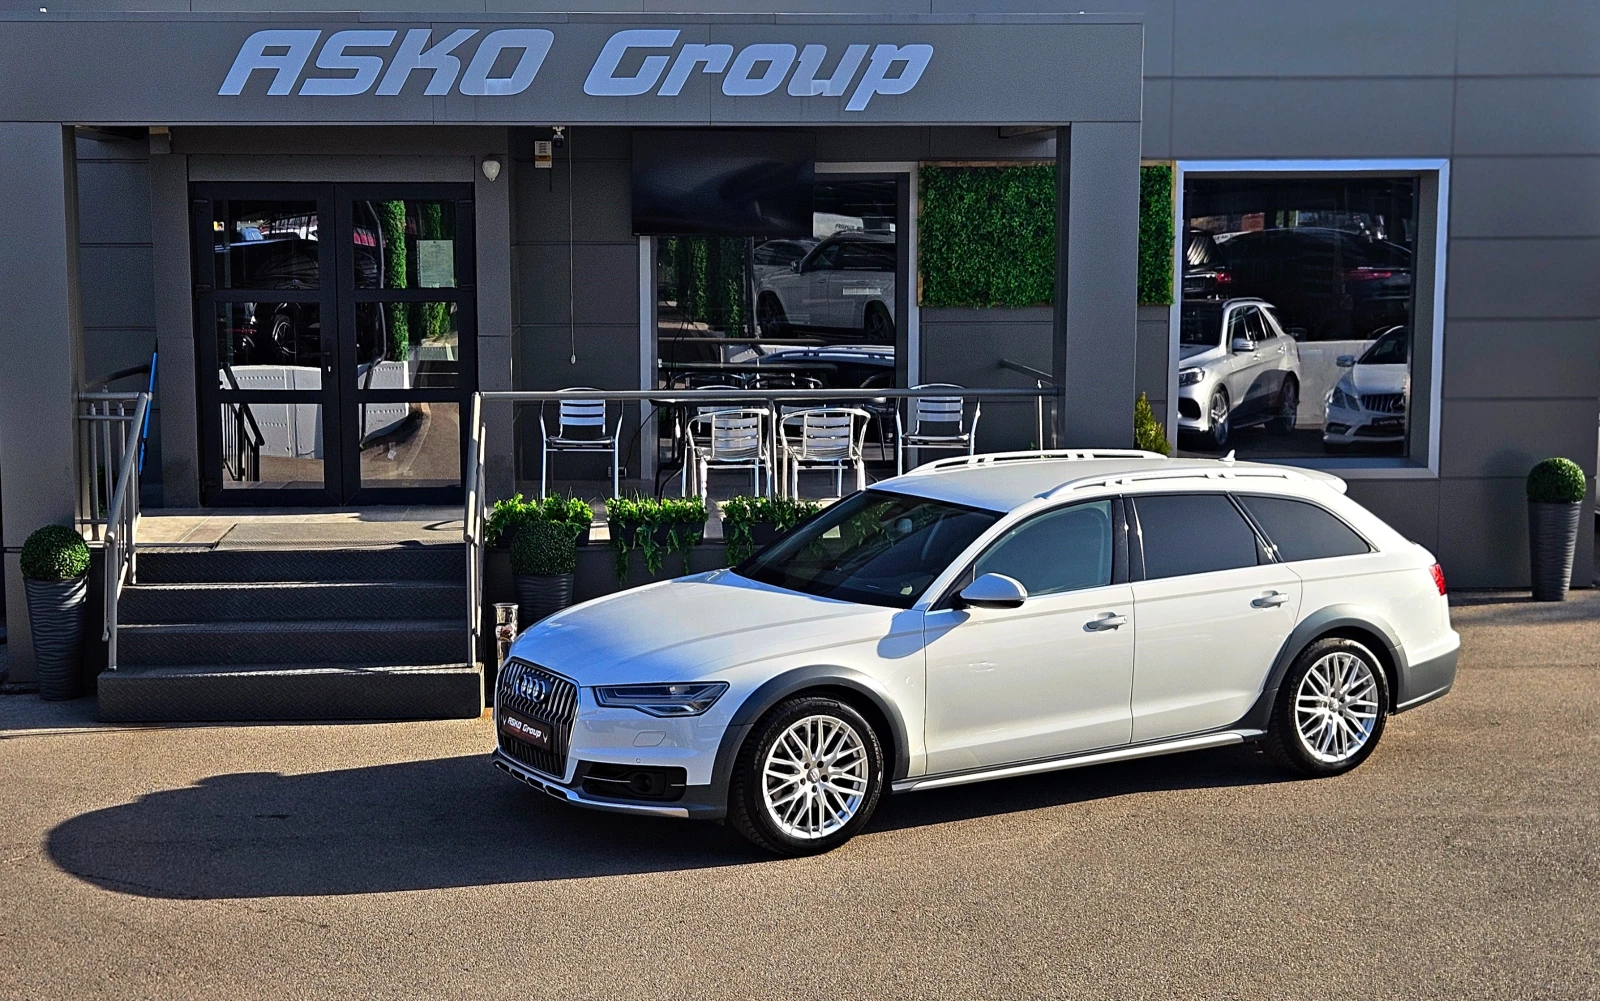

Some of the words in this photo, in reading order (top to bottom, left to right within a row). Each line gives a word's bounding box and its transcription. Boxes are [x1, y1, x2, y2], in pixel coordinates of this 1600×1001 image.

[218, 28, 555, 97] ASKO
[583, 29, 934, 112] Group
[507, 716, 522, 730] ASKO
[522, 723, 542, 739] Group
